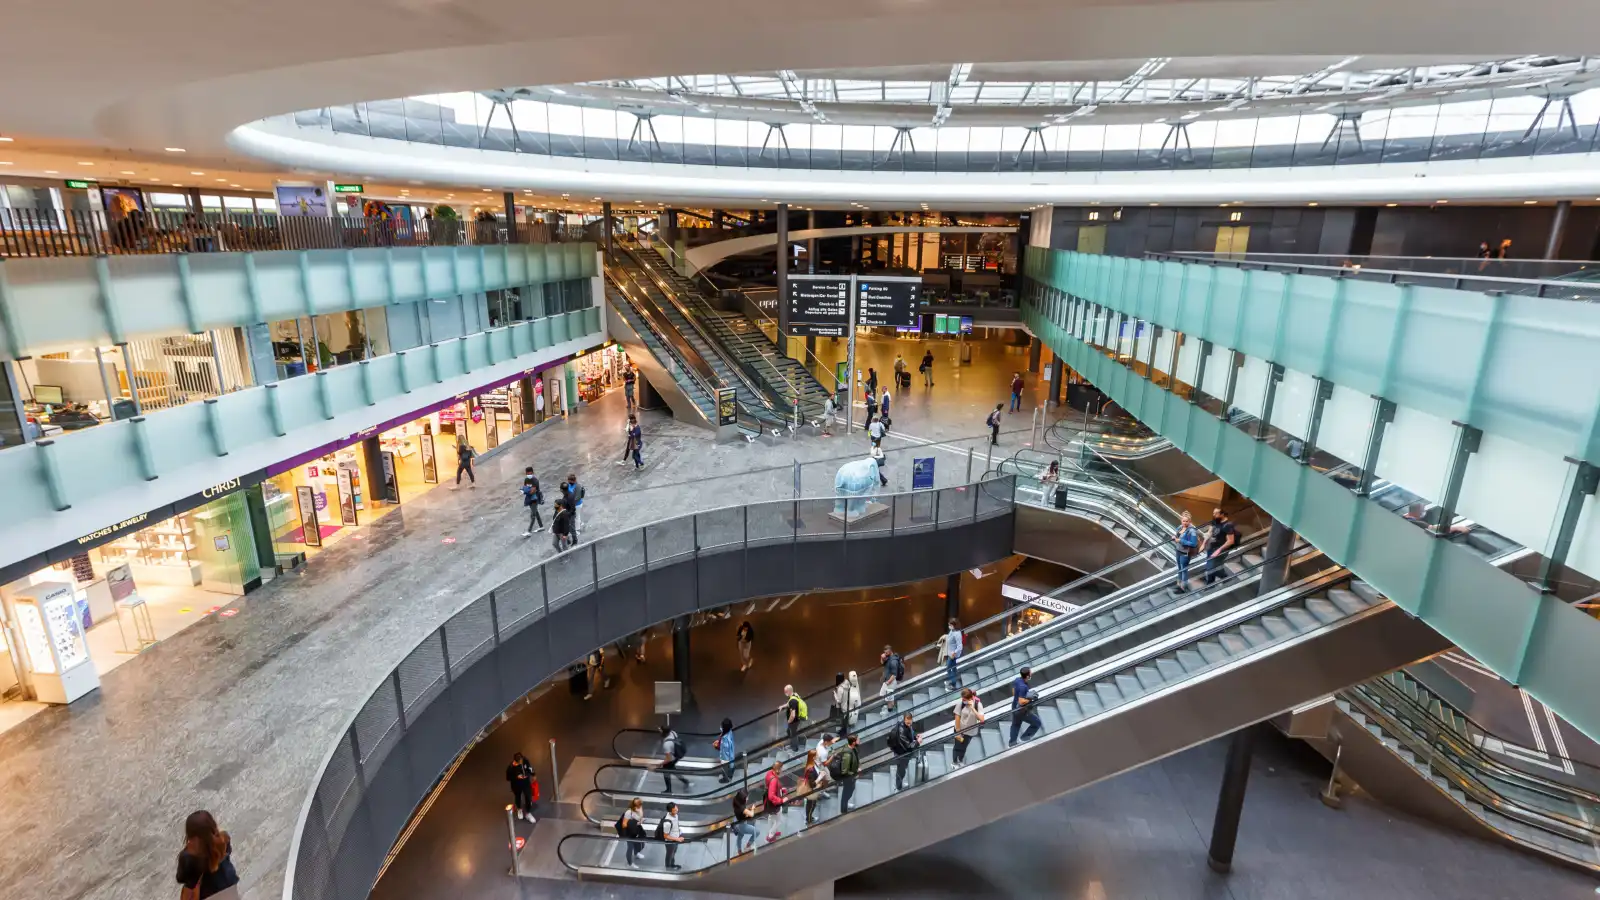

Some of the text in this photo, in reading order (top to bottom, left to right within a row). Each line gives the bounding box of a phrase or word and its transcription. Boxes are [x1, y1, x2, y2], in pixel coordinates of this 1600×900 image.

[202, 476, 241, 499] CHRIST
[77, 512, 148, 545] WATCHES & JEWELRY
[1022, 593, 1077, 613] BRZELKÖNI
